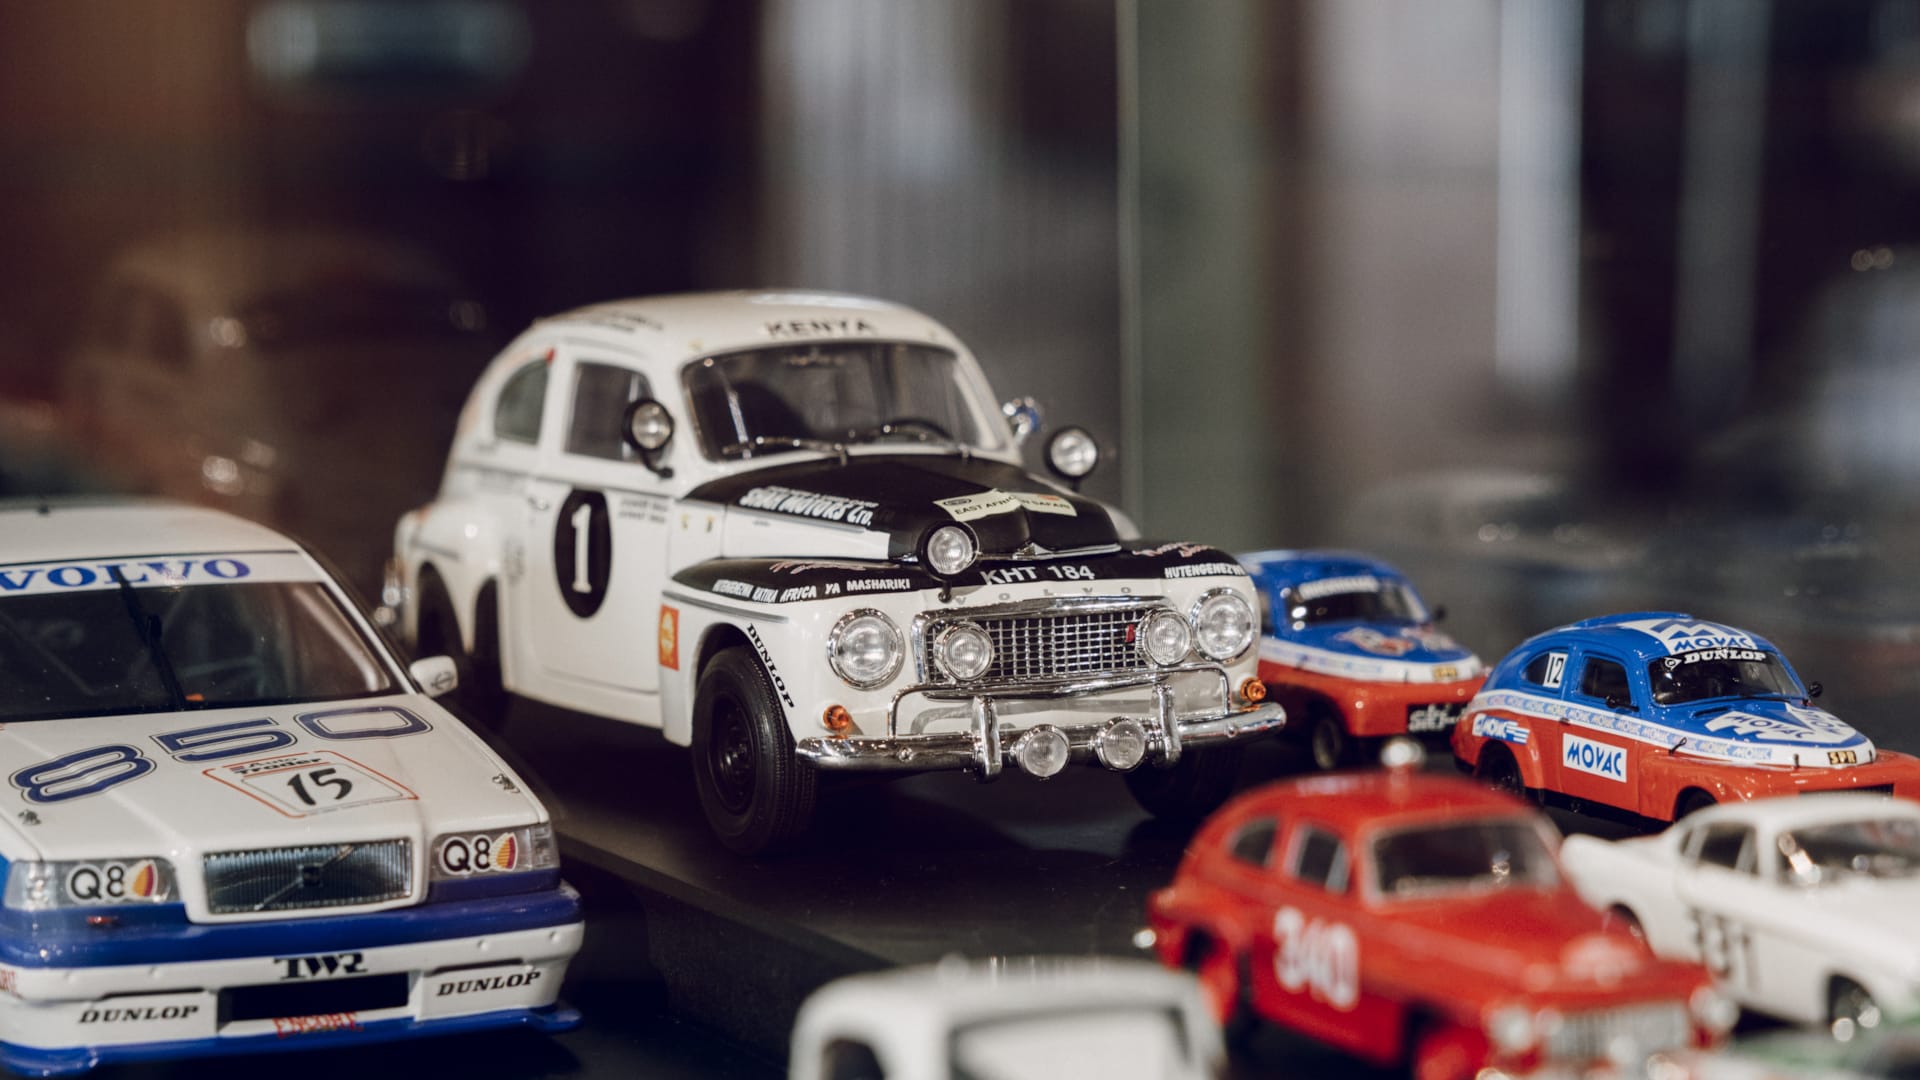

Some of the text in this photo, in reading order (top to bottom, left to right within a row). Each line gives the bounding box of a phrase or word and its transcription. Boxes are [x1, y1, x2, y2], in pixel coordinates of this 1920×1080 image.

[766, 320, 877, 338] KENYA
[778, 495, 845, 521] MOTORS
[954, 504, 983, 515] EAST
[571, 503, 593, 594] 1
[0, 558, 251, 592] VOLVO
[980, 565, 1096, 585] KHT 184
[780, 585, 817, 603] AFRICA
[825, 583, 841, 595] YA
[847, 578, 911, 592] MASHARIKI
[1674, 636, 1753, 653] MOVAC
[1684, 649, 1766, 665] DUNLOP
[747, 623, 795, 709] DUNLOP
[1547, 656, 1565, 684] 12
[1724, 715, 1815, 739] MOVAC
[8, 706, 434, 805] 850
[1567, 741, 1622, 777] MOVAC
[287, 767, 354, 806] 15
[443, 836, 492, 873] Q8
[70, 865, 125, 900] Q8
[436, 971, 541, 998] DUNLOP
[78, 1004, 200, 1024] DUNLOP
